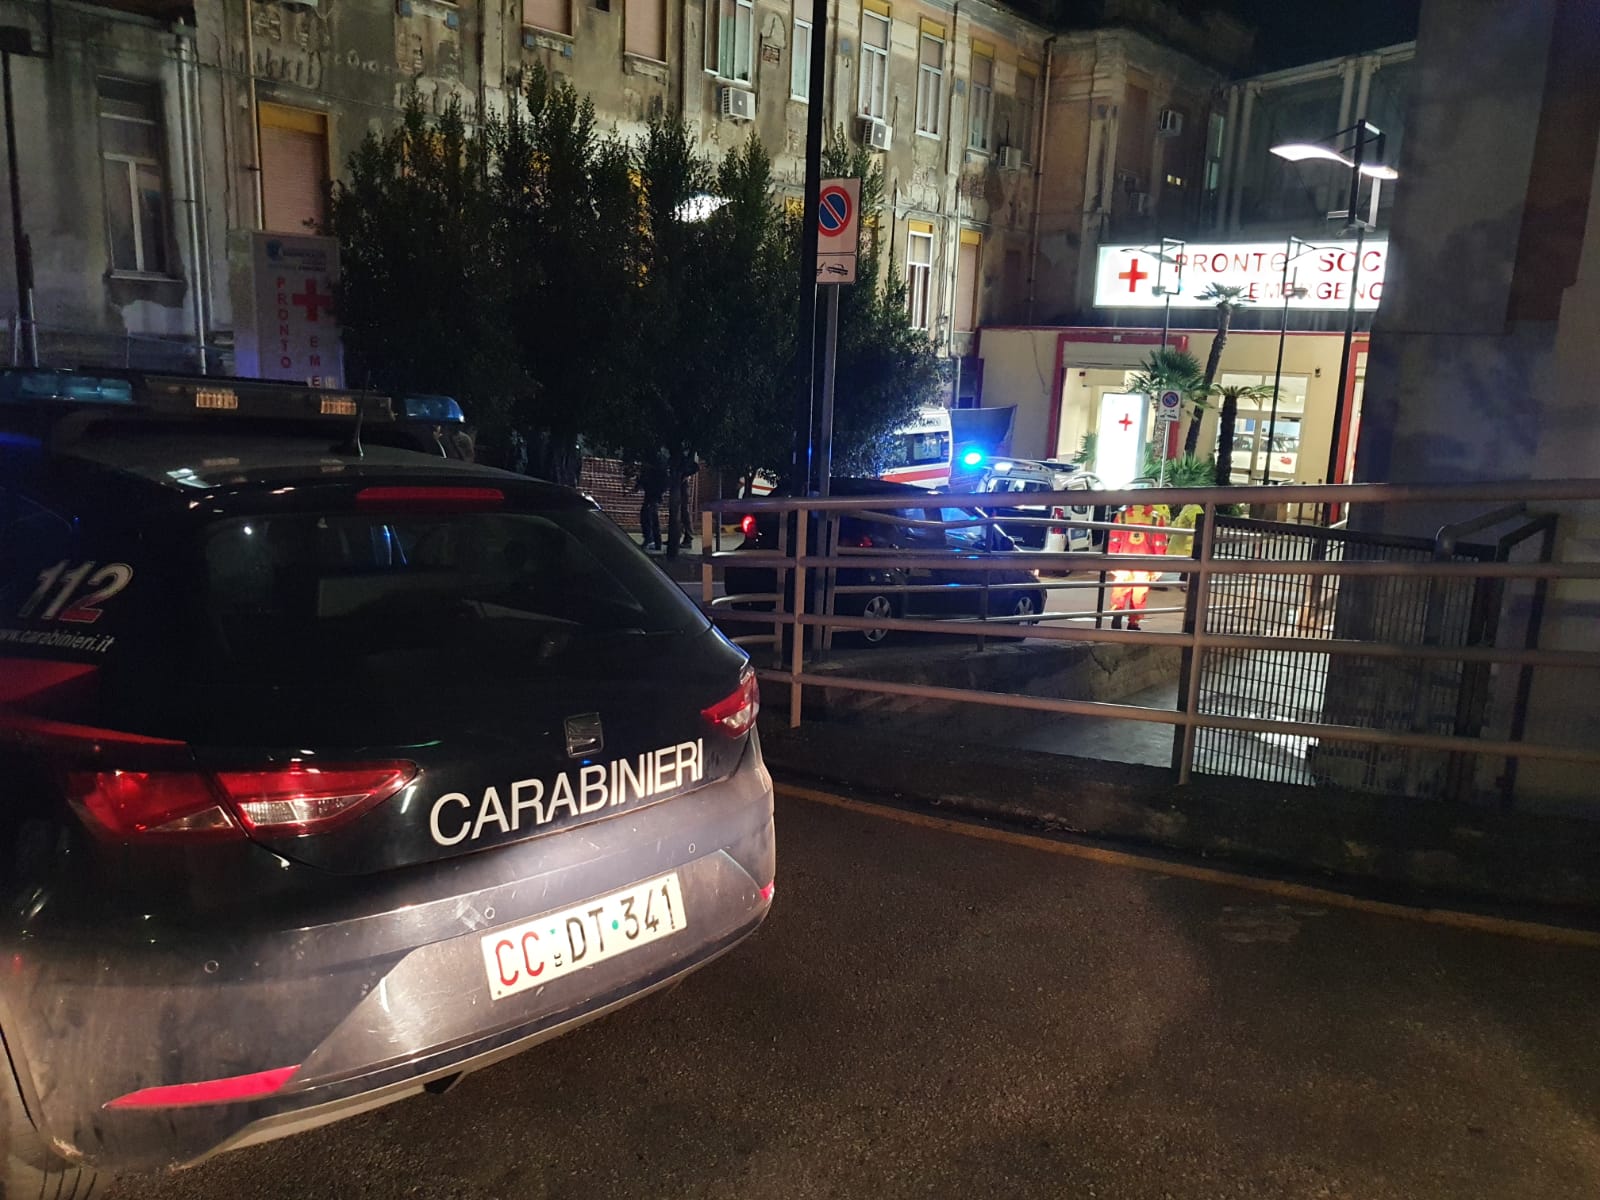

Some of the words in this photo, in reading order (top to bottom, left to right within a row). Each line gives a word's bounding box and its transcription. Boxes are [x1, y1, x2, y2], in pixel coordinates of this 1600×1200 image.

[1174, 253, 1287, 273] PRONTO
[276, 277, 291, 368] PRONTO
[18, 559, 133, 623] 112
[429, 738, 704, 846] CARABINIERI
[495, 931, 545, 986] CC
[566, 907, 605, 963] DT
[620, 884, 677, 940] 341
